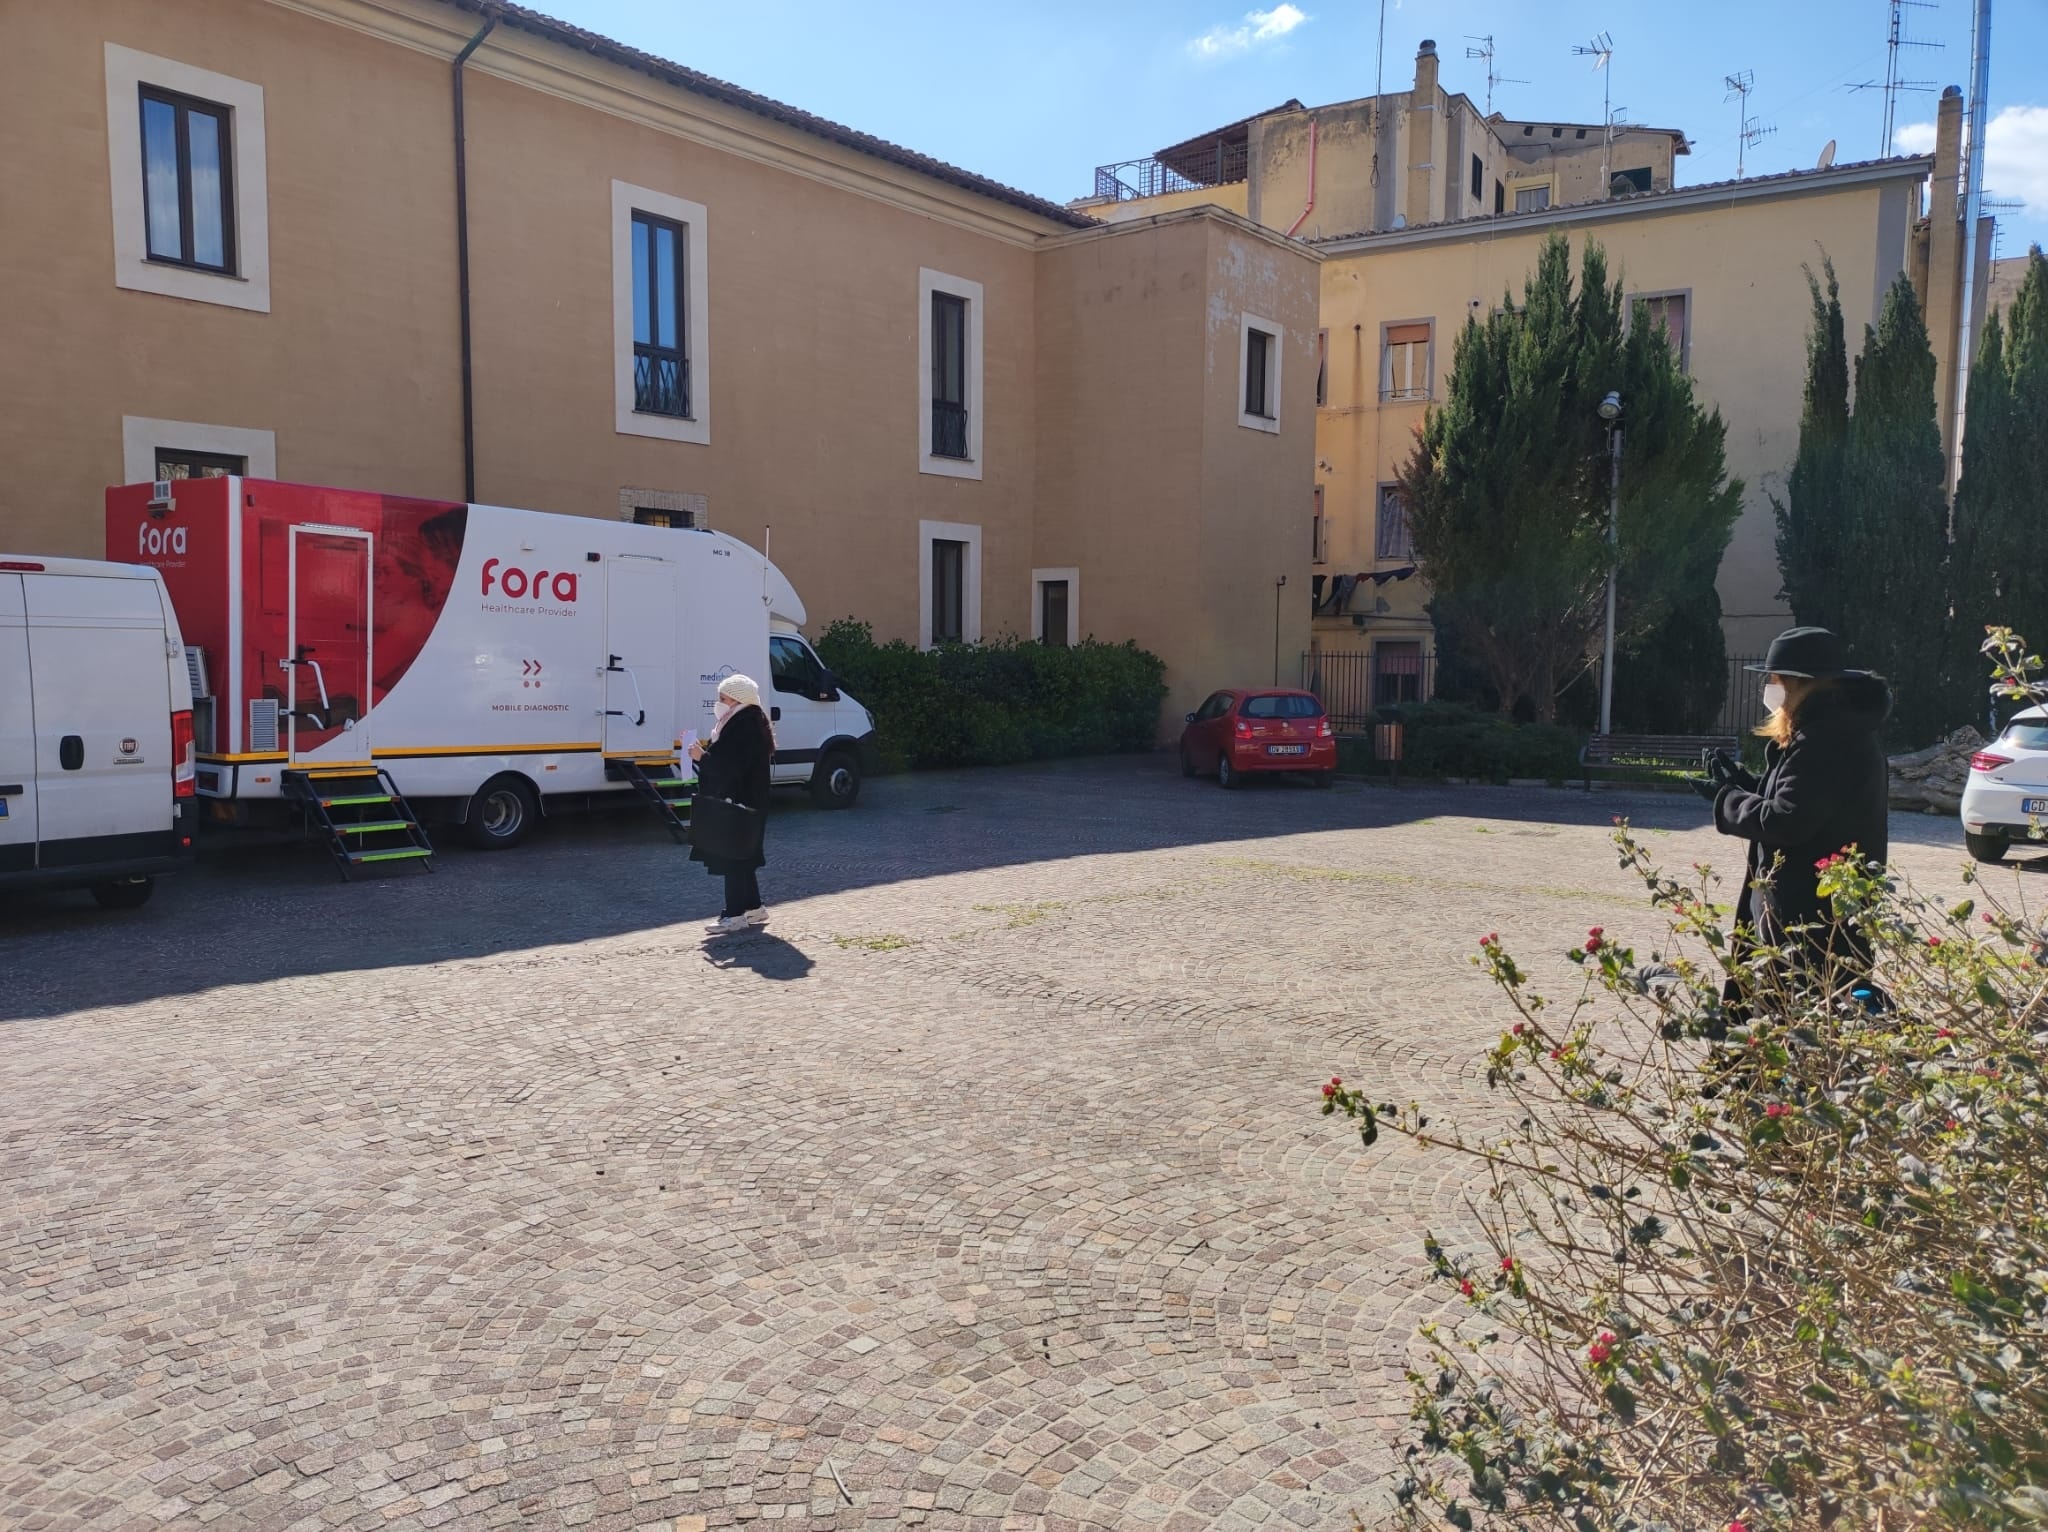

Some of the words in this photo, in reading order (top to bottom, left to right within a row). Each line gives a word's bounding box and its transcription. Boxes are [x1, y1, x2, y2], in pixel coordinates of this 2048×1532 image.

[139, 521, 187, 555] fora
[481, 558, 577, 602] fora
[481, 602, 536, 615] Healthcare
[538, 606, 577, 618] Provider
[700, 672, 727, 681] medish
[492, 704, 522, 712] MOBILE
[524, 704, 570, 712] DIAGNOSTIC
[2031, 800, 2046, 812] GD
